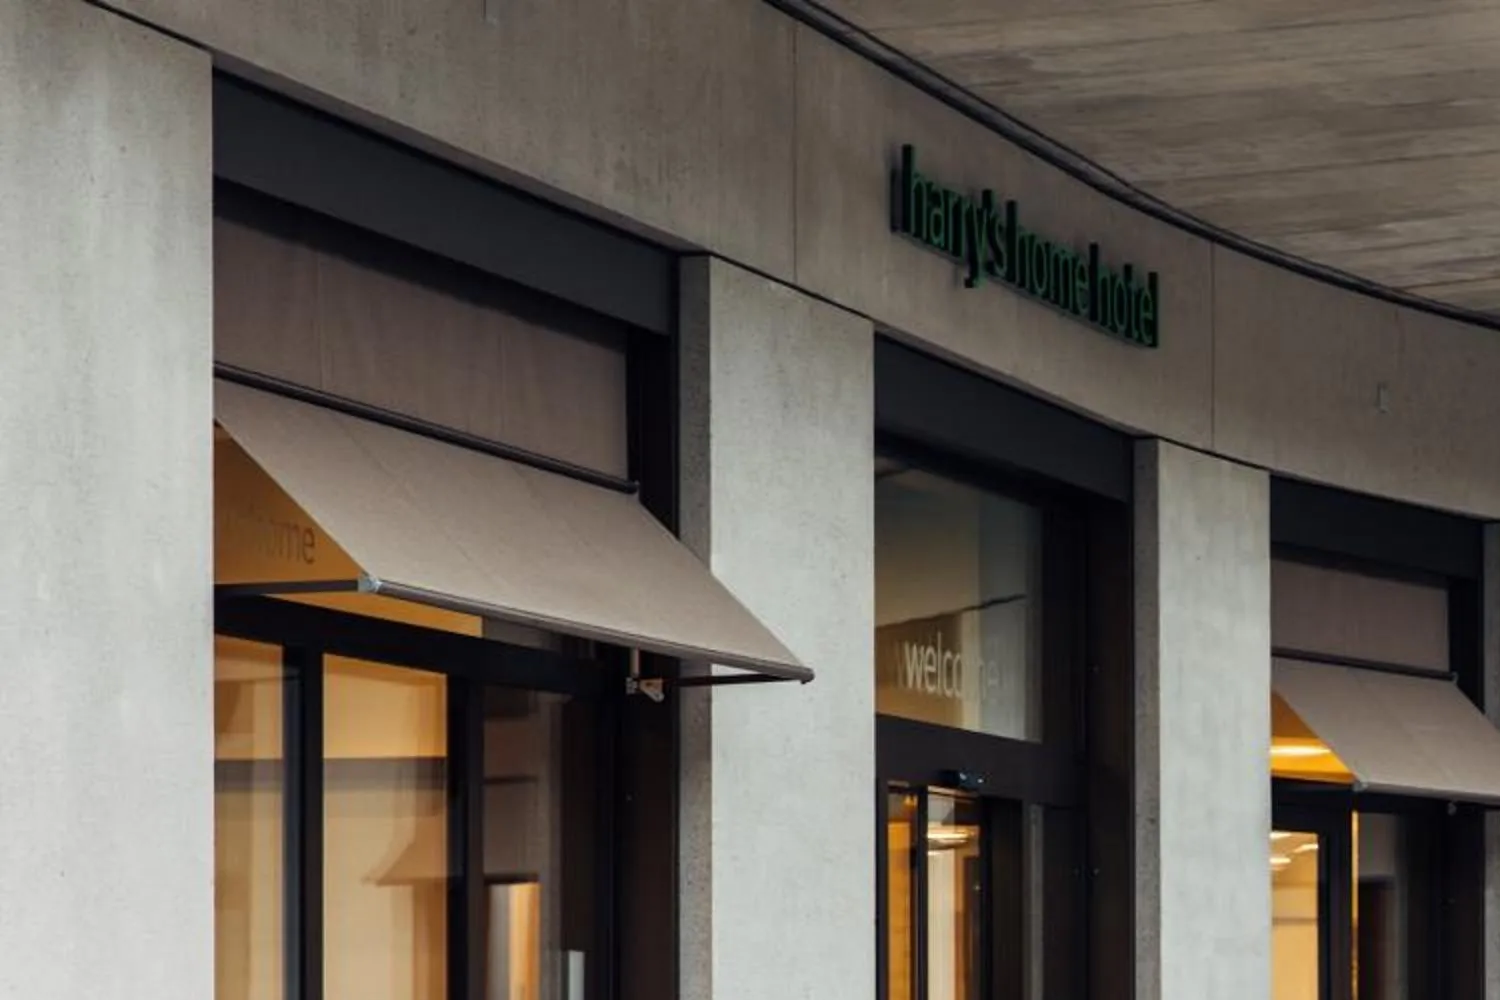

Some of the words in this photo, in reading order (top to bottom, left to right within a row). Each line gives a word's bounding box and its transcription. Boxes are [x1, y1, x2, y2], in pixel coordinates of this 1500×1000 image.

[890, 143, 1008, 288] harry's
[1005, 200, 1090, 313] home
[1089, 242, 1158, 348] hotel
